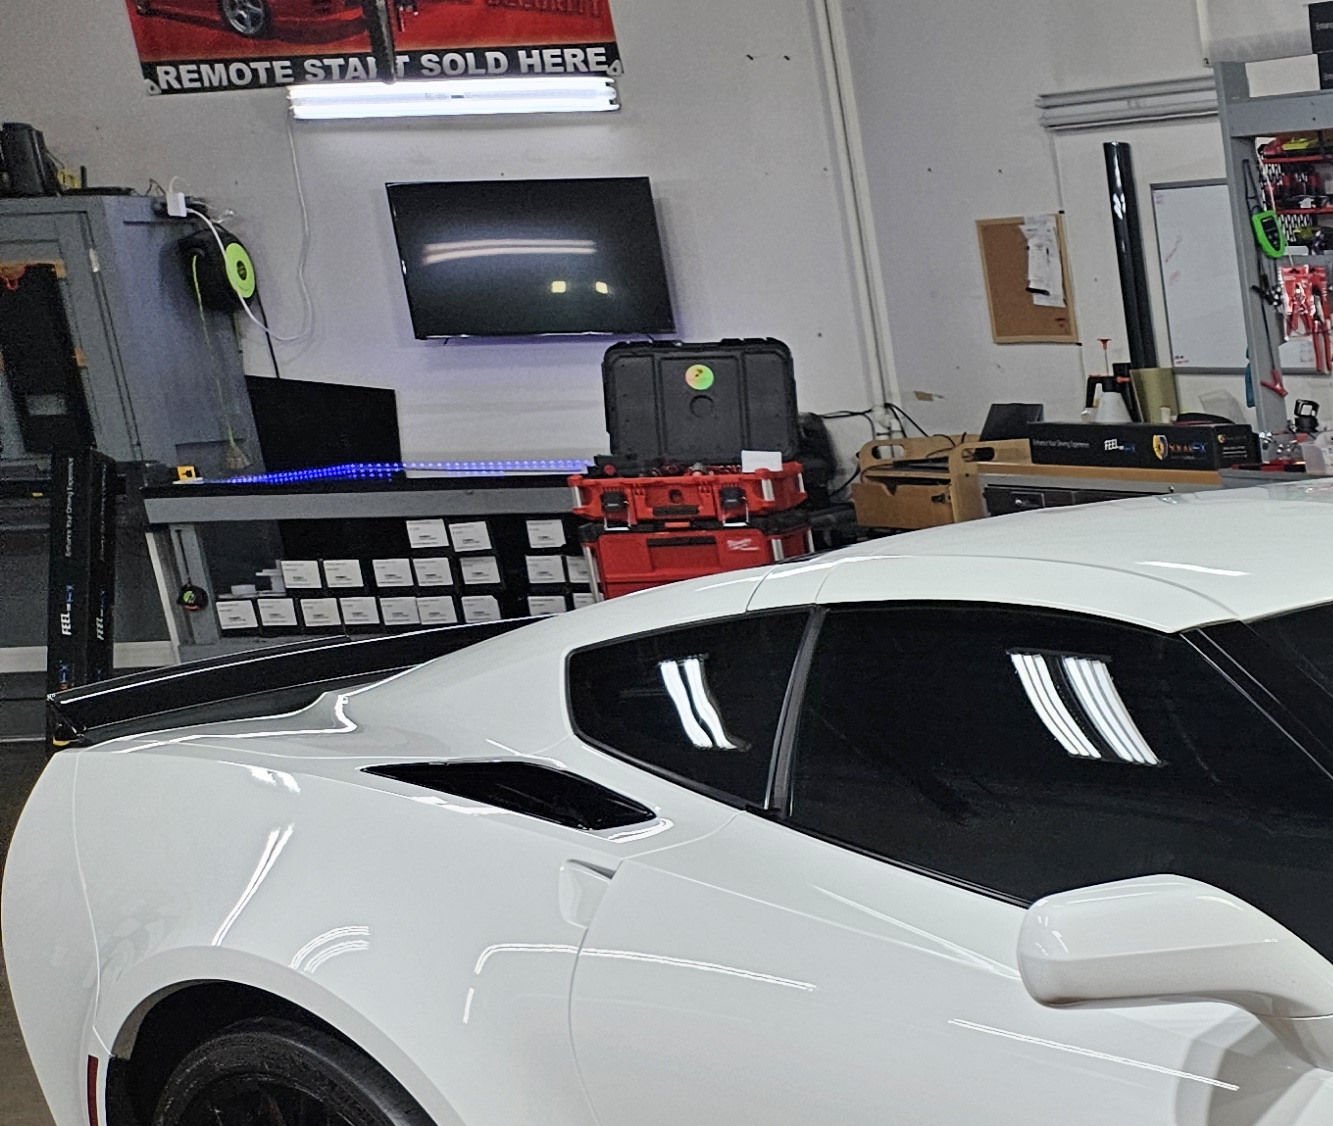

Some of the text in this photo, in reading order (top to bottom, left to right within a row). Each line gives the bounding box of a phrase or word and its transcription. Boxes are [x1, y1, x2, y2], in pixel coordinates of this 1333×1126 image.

[157, 60, 294, 90] REMOTE
[420, 51, 509, 78] SOLD
[517, 47, 607, 75] HERE
[60, 612, 72, 636] FEEL
